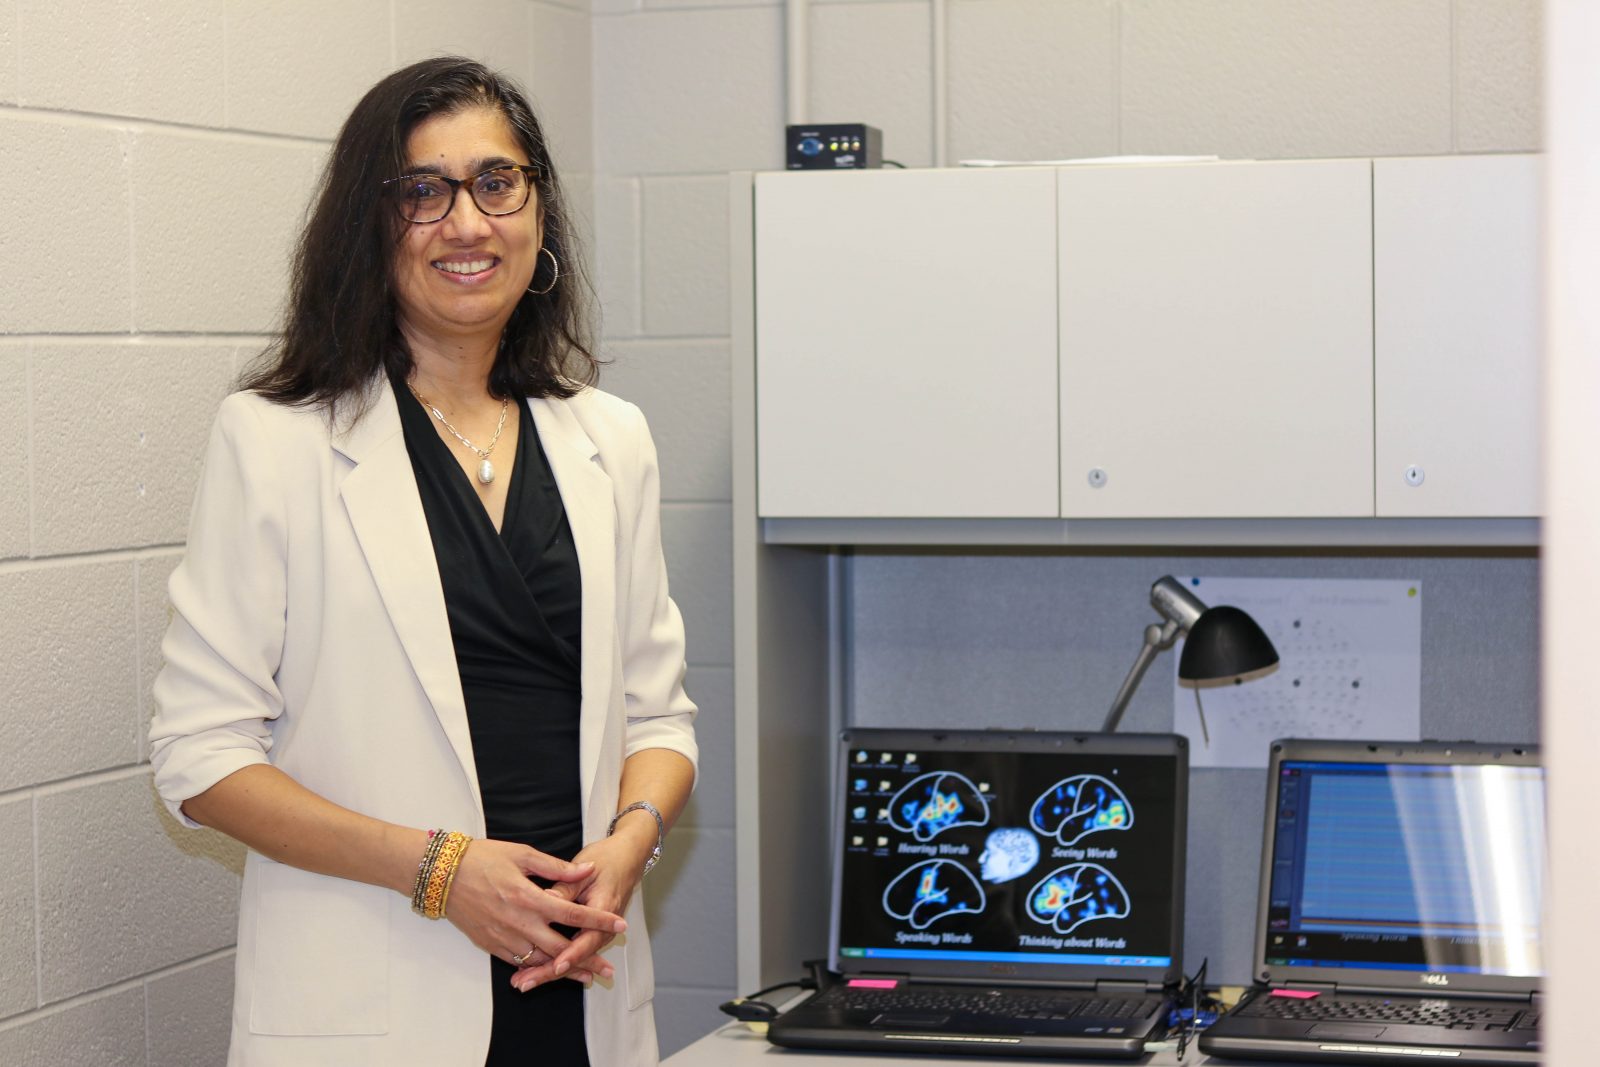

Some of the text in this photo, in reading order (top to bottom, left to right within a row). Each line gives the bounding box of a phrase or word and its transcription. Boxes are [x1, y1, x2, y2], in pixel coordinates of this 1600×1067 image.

[897, 842, 937, 856] Hearing
[940, 843, 970, 855] Words
[1051, 846, 1118, 860] Seeing Words
[895, 931, 973, 945] Speaking Words
[1019, 935, 1126, 949] Thinking about Words
